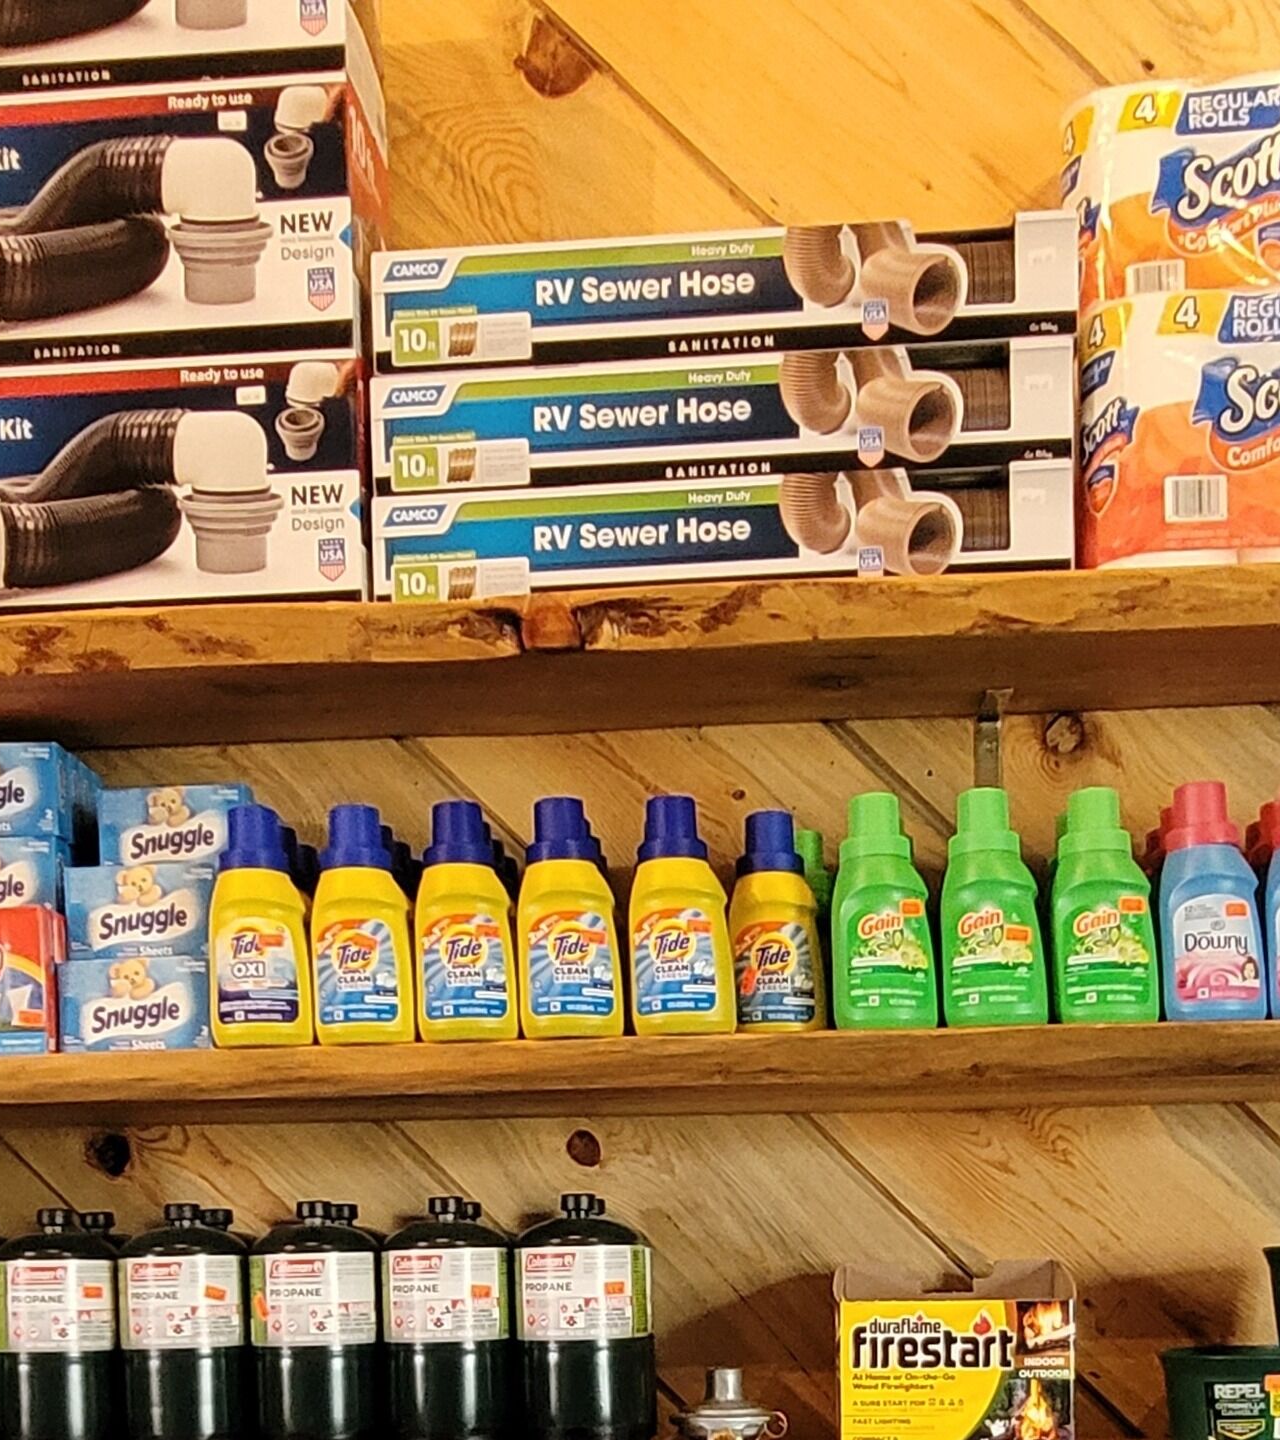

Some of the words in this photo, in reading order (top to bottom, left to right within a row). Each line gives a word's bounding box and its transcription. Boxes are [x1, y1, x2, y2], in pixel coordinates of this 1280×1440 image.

[167, 94, 210, 111] Ready
[212, 93, 226, 107] to
[1133, 94, 1157, 123] 4
[1188, 108, 1250, 129] ROLLS
[280, 211, 334, 235] NEW
[280, 245, 335, 262] Design
[691, 245, 727, 258] Heavy
[729, 243, 755, 256] Duty
[392, 263, 439, 277] CAMCO
[535, 278, 574, 306] RV
[581, 276, 672, 304] Sewer
[679, 270, 756, 298] Hose
[1174, 296, 1200, 329] 4
[400, 328, 427, 353] 10
[668, 335, 775, 353] SANITATION
[180, 368, 221, 384] Ready
[224, 368, 238, 380] to
[688, 372, 724, 384] Heavy
[726, 370, 752, 382] Duty
[391, 389, 438, 404] CAMCO
[533, 405, 572, 433] RV
[579, 403, 670, 431] Sewer
[676, 398, 752, 424] Hose
[399, 454, 426, 478] 10
[665, 462, 771, 479] SANITATION
[291, 484, 344, 506] NEW
[688, 492, 724, 504] Heavy
[726, 491, 751, 503] Duty
[291, 516, 345, 532] Design
[392, 508, 438, 523] CAMCO
[533, 525, 572, 552] RV
[579, 523, 670, 549] Sewer
[676, 517, 752, 544] Hose
[400, 572, 427, 597] 10
[130, 823, 215, 859] Snuggle
[99, 902, 188, 940] Snuggle
[860, 914, 901, 936] Gain
[960, 910, 1001, 936] Gain
[1076, 912, 1118, 935] Gain
[445, 937, 482, 963] Tide
[1183, 931, 1249, 955] Downy
[337, 945, 372, 969] Tide
[232, 961, 265, 978] OXI
[446, 970, 481, 979] CLEAN
[554, 966, 589, 975] CLEAN
[655, 965, 690, 974] CLEAN
[91, 996, 180, 1034] Snuggle
[392, 1284, 440, 1294] PROPANE
[524, 1281, 572, 1292] PROPANE
[10, 1294, 65, 1305] PROPANE
[869, 1317, 942, 1335] duraflame
[851, 1326, 1014, 1369] firestart
[1023, 1356, 1066, 1367] INDOOR
[852, 1373, 863, 1381] At
[864, 1373, 892, 1381] Home
[1018, 1369, 1070, 1379] OUTDOOR
[852, 1382, 879, 1390] Wood
[1213, 1383, 1265, 1399] REPEL
